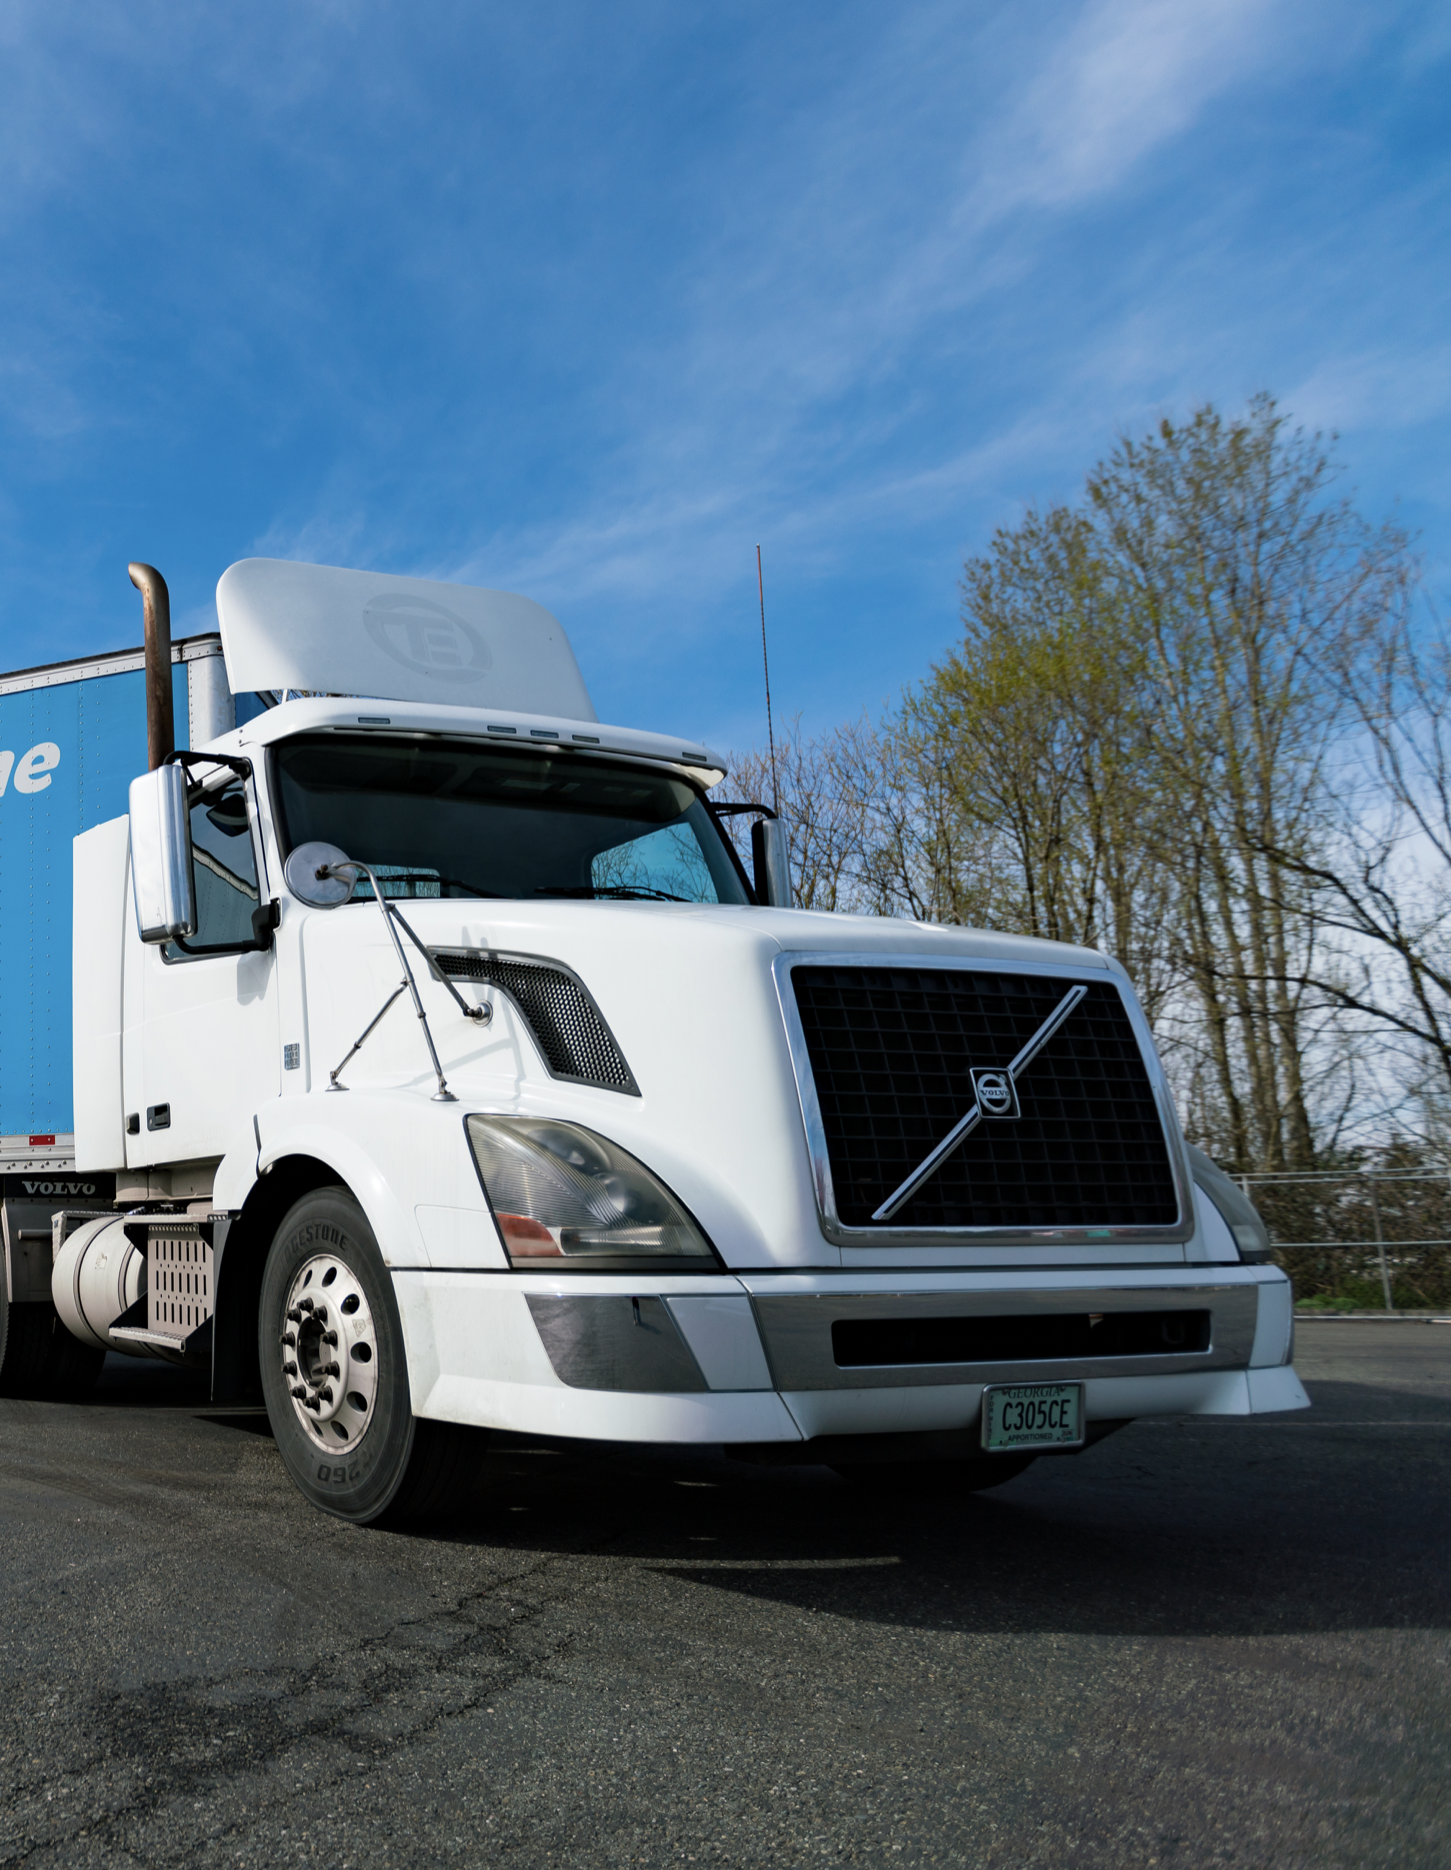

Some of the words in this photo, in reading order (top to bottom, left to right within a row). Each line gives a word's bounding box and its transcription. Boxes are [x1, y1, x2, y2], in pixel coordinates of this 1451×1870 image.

[21, 1180, 96, 1195] VOLVO
[1007, 1387, 1061, 1398] GEORGIA
[1002, 1398, 1071, 1431] C305CE
[1007, 1432, 1053, 1442] APPORTIONED
